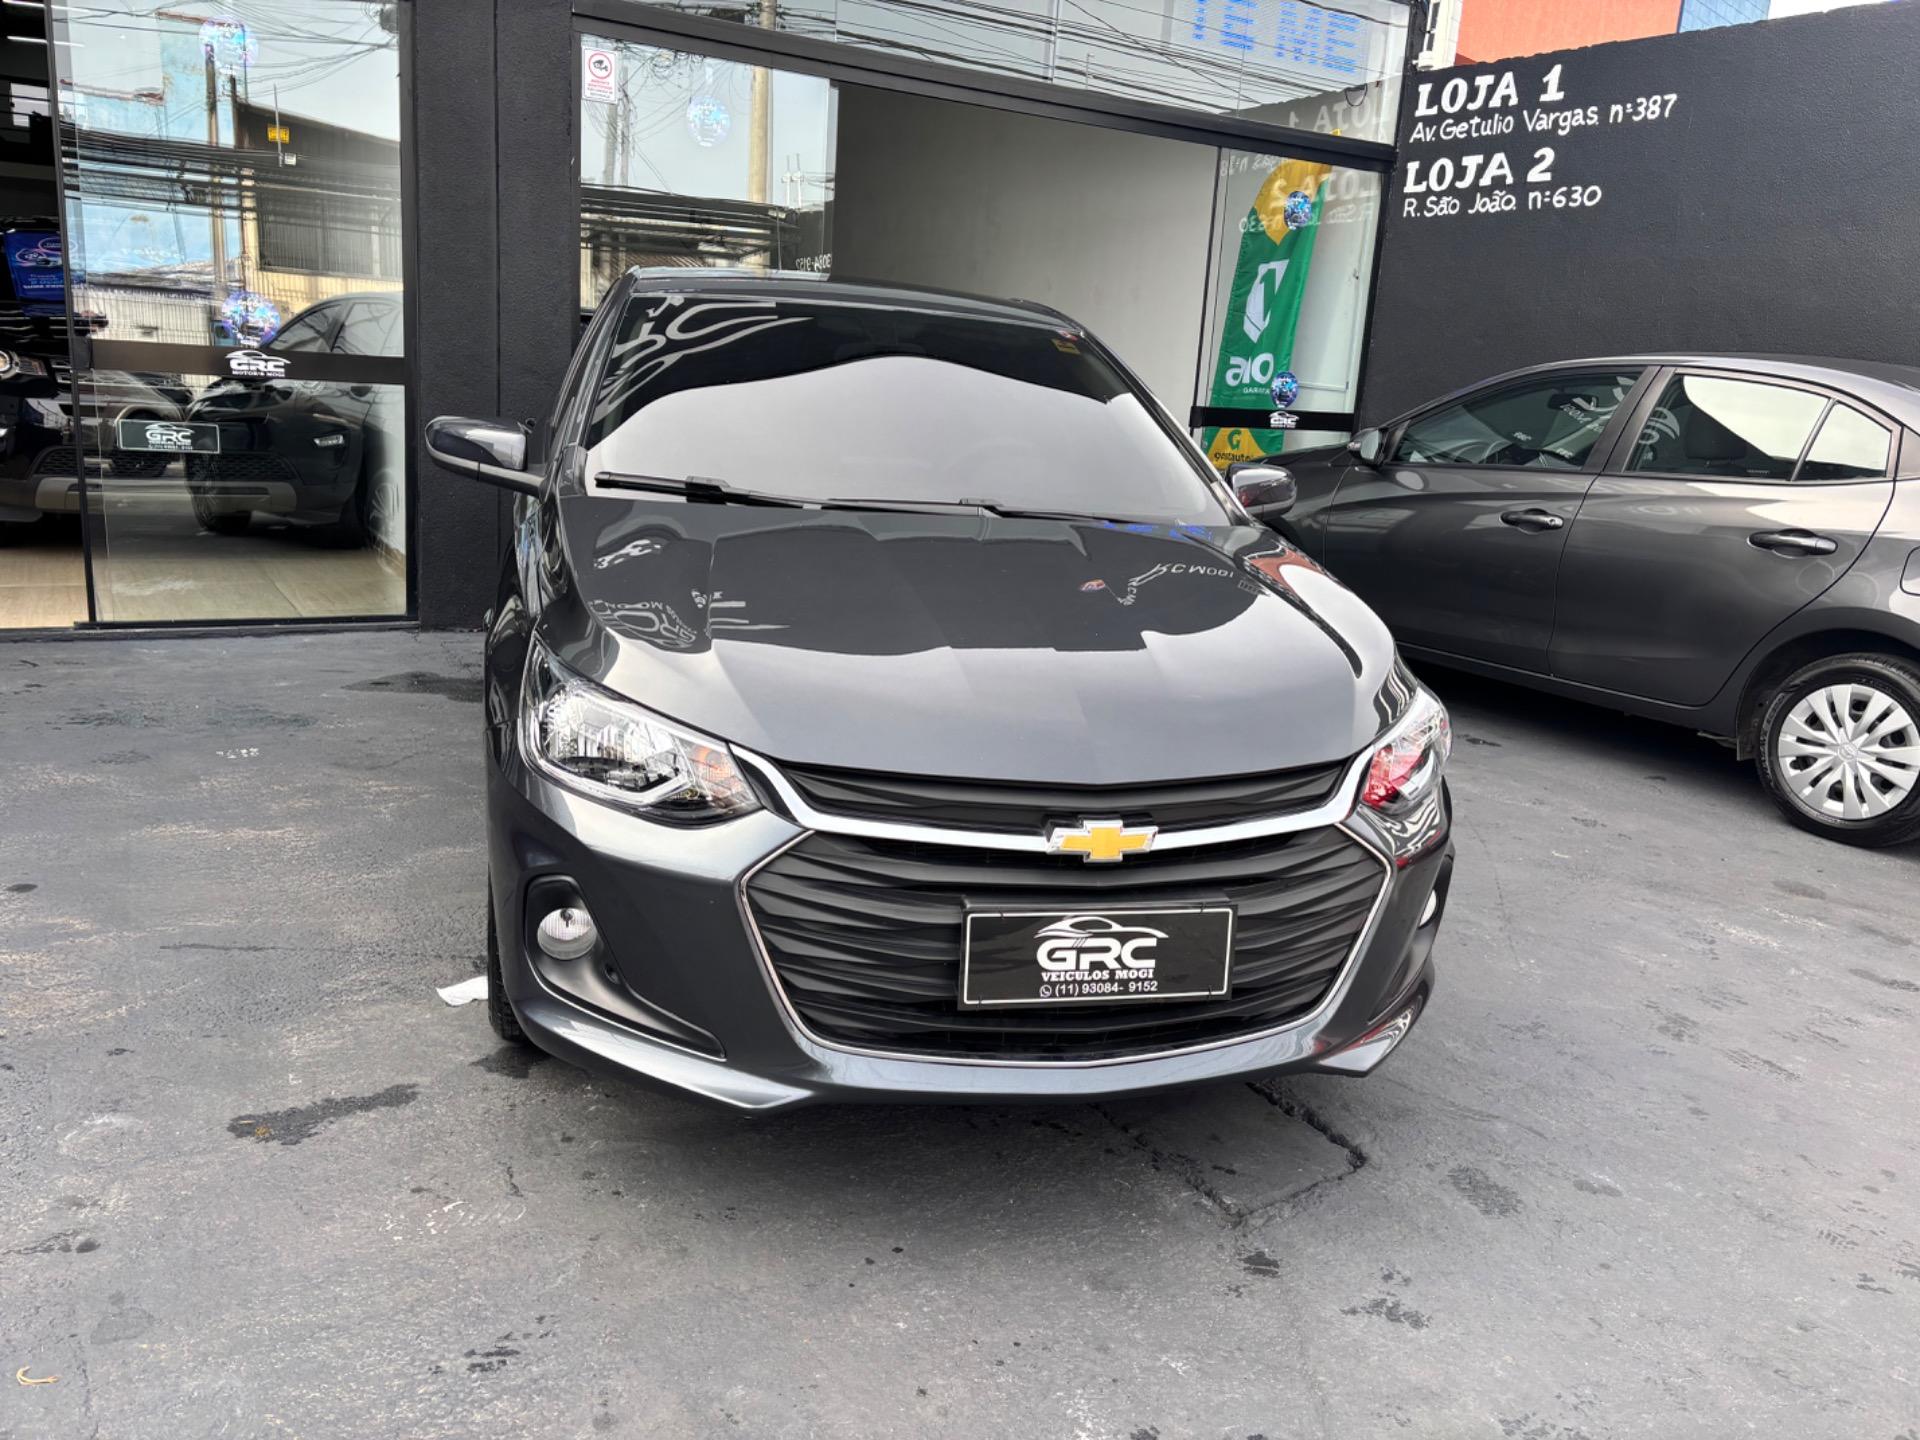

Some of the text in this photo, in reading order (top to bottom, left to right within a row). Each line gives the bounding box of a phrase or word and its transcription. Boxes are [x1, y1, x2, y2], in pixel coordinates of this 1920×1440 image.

[1415, 64, 1565, 117] LOJA 1
[1403, 147, 1555, 193] LOJA 2
[146, 429, 191, 443] GRC
[1036, 937, 1158, 970] GRC
[1041, 968, 1154, 982] VEICULOS MOGI
[1055, 983, 1079, 997] (11)
[1128, 980, 1158, 992] 9152
